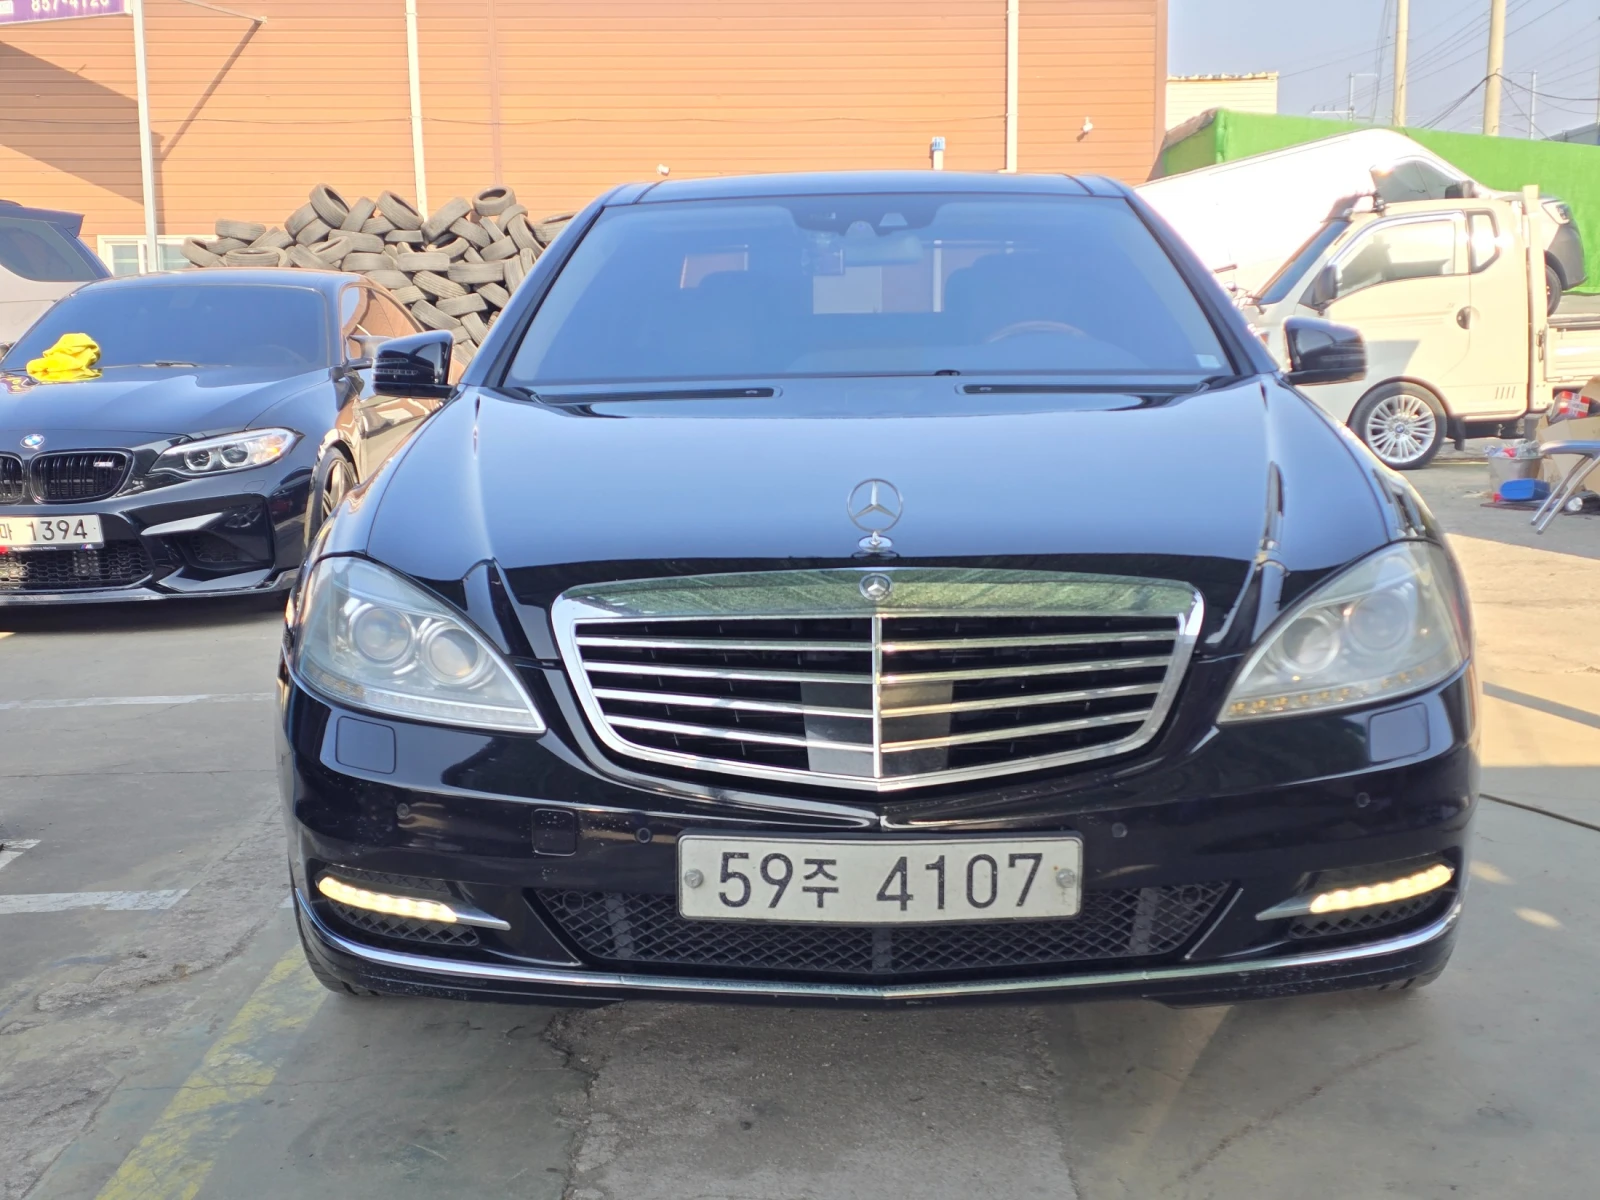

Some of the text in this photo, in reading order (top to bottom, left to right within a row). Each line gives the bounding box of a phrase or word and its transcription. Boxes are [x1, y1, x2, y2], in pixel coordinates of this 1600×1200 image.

[26, 519, 88, 541] 1394
[717, 852, 1043, 911] 59주 4107
